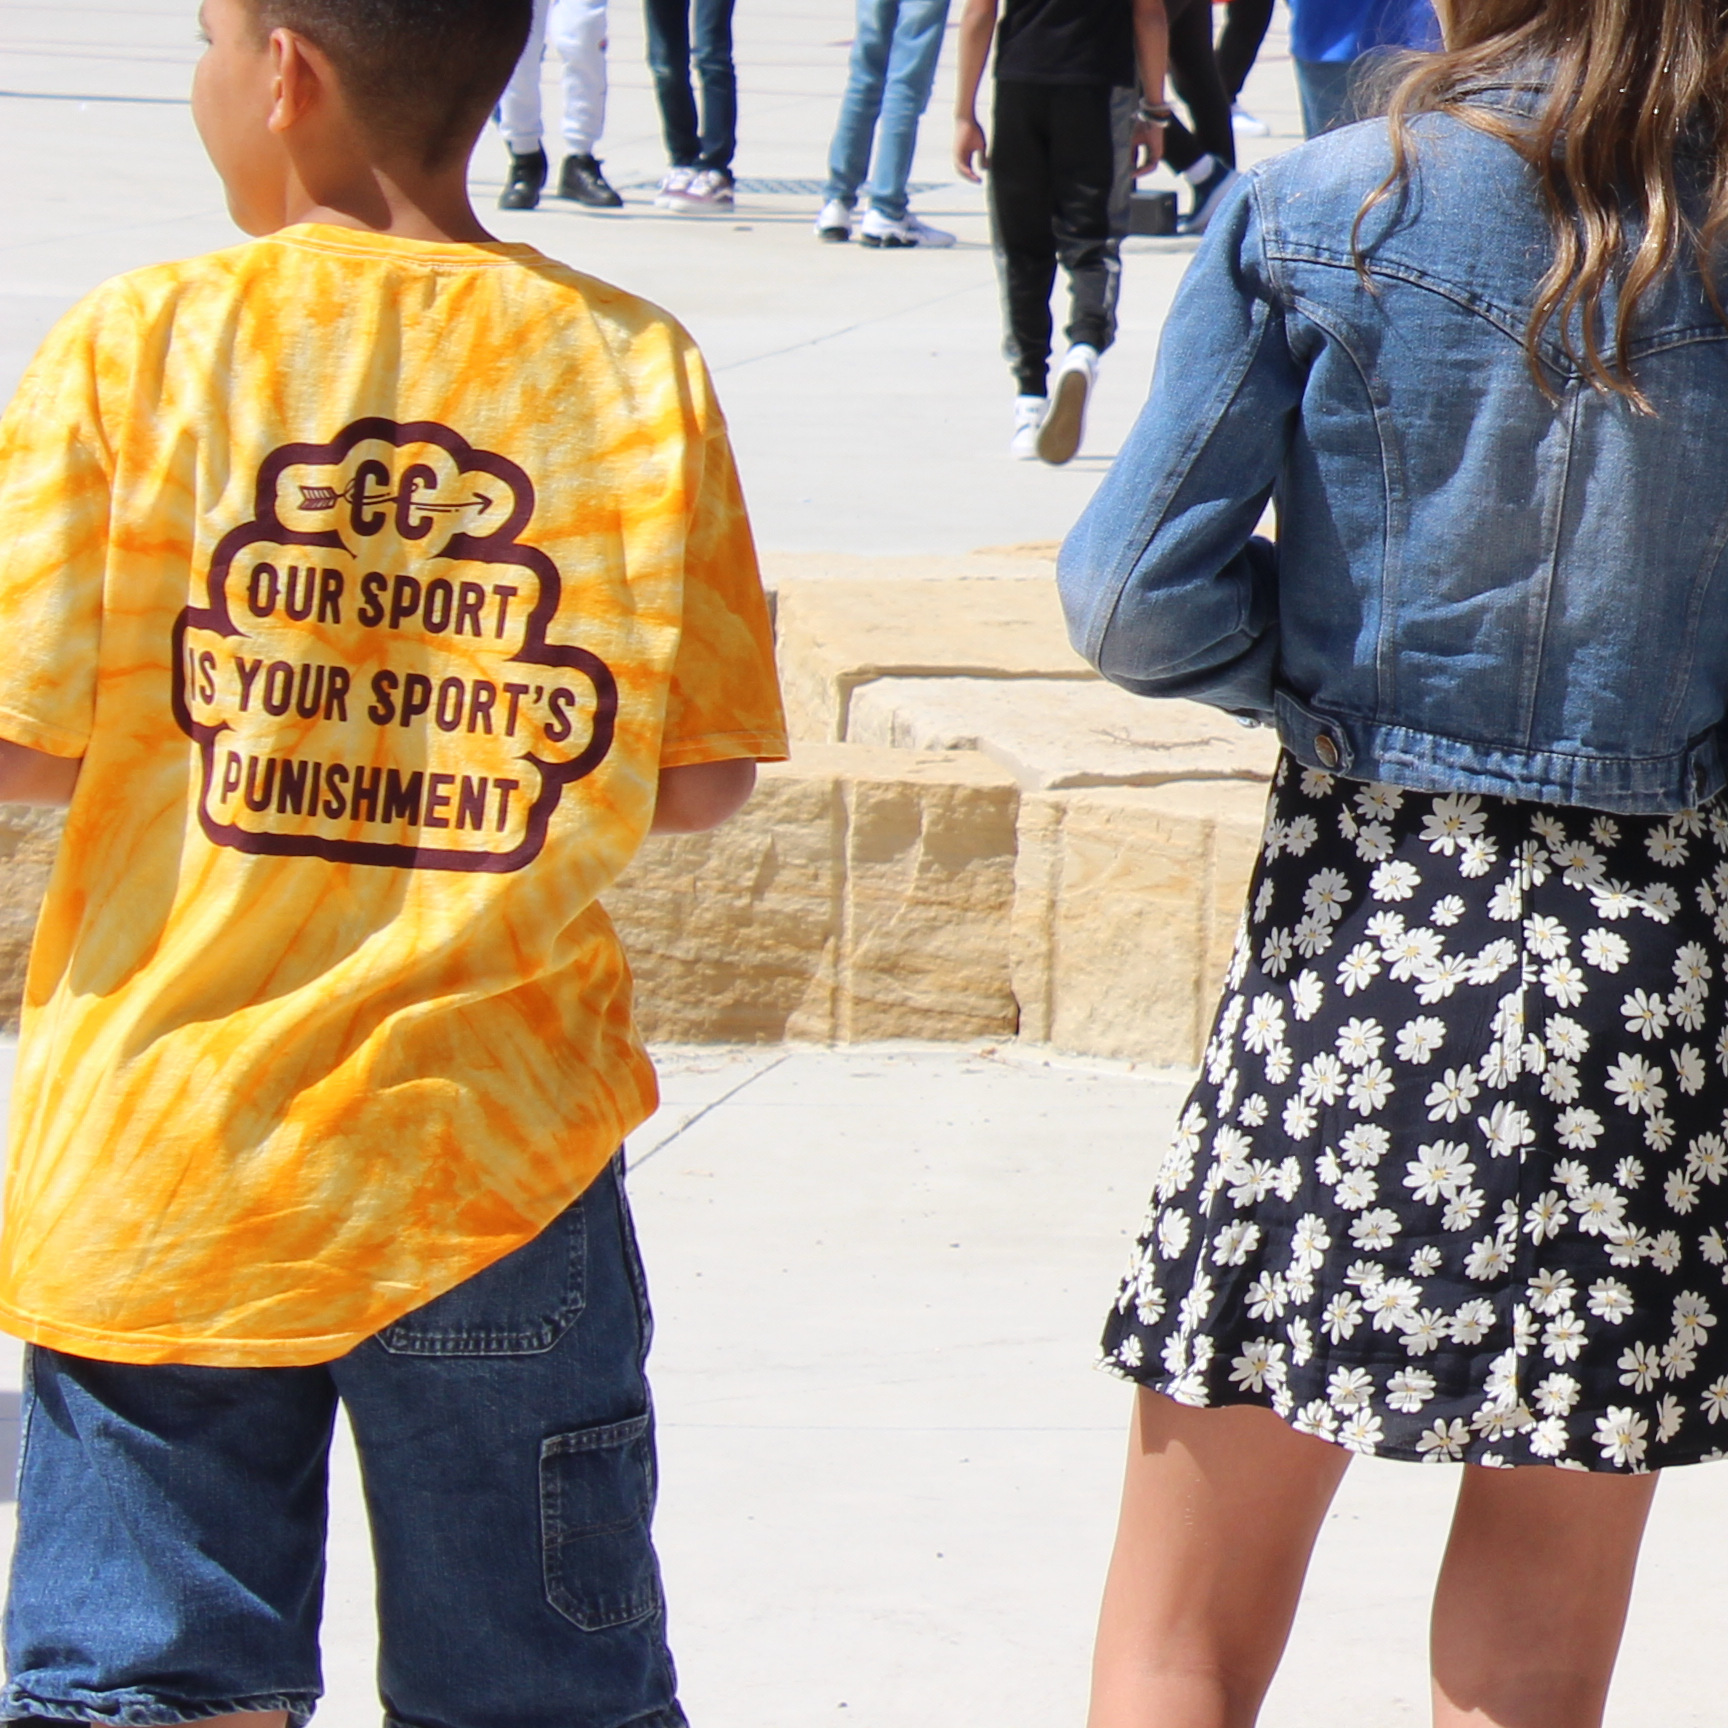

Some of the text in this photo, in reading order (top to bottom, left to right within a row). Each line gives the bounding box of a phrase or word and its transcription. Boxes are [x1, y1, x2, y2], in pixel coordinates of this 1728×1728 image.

[350, 459, 438, 540] CC
[247, 561, 518, 640] OUR SPORT
[188, 647, 576, 743] IS YOUR SPORT'S
[221, 750, 519, 833] PUNISHMENT
